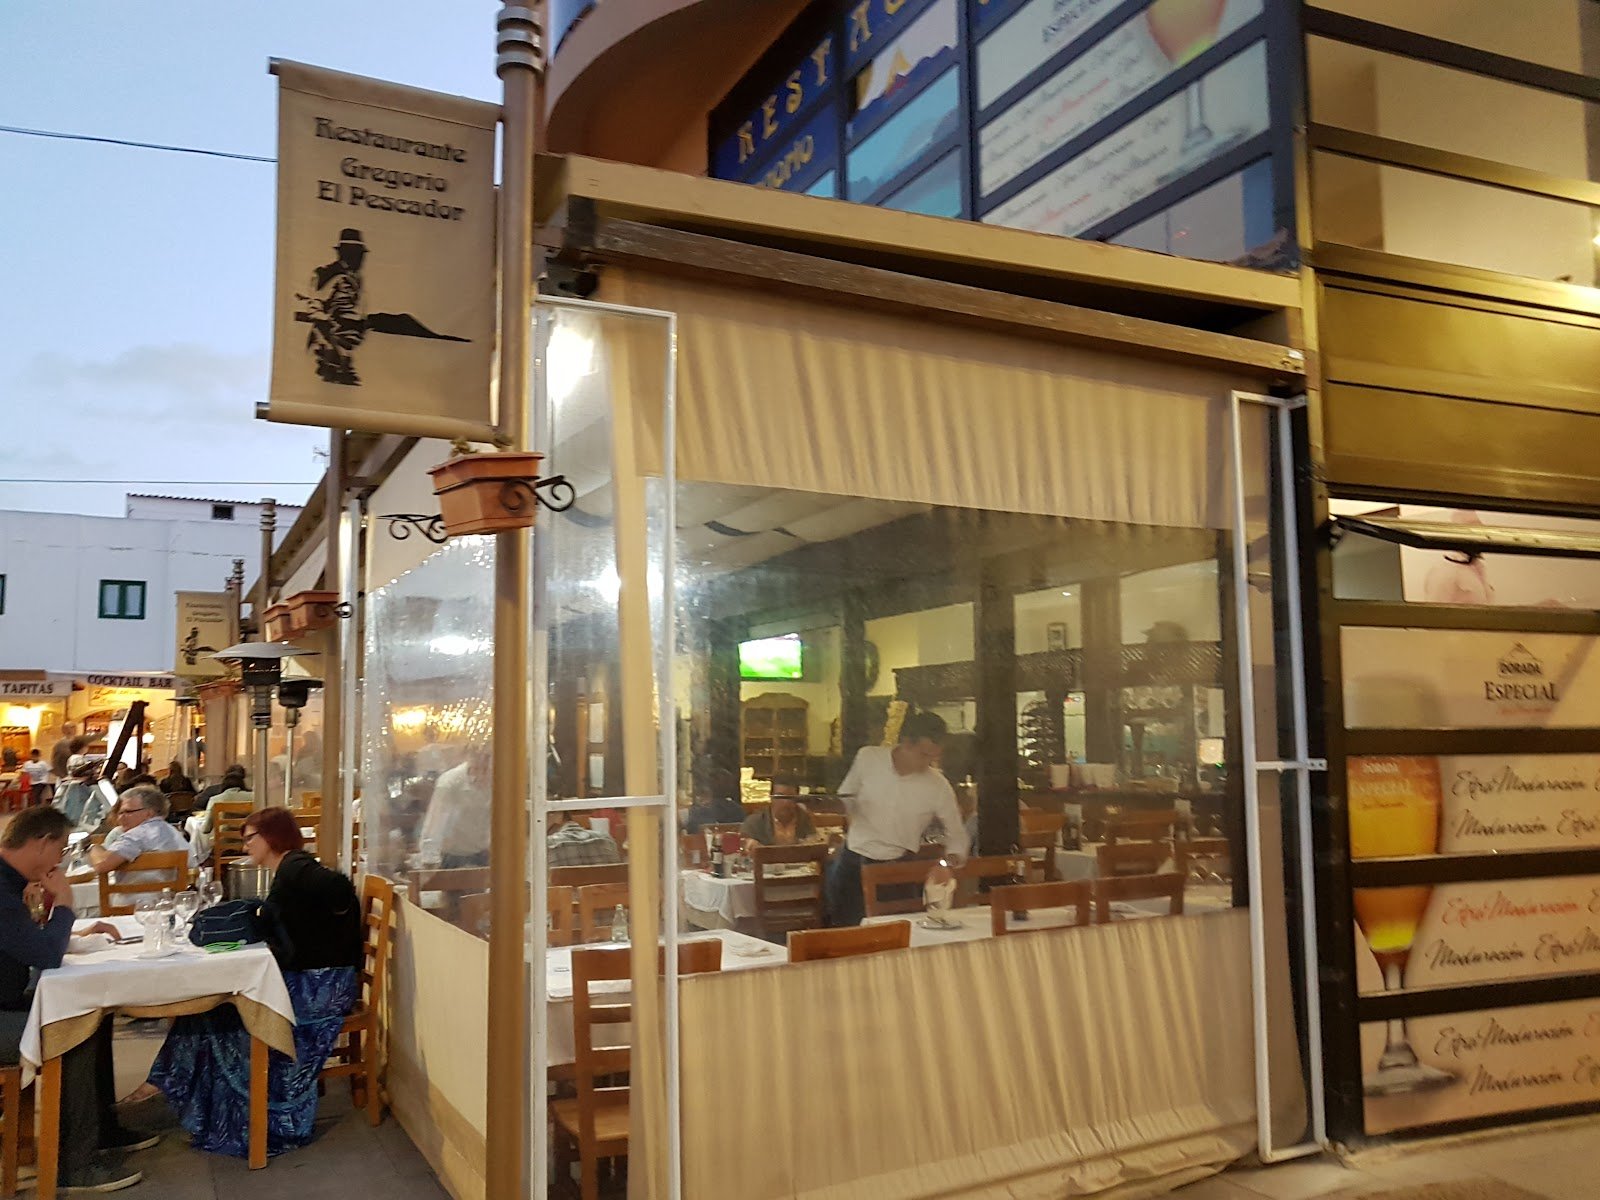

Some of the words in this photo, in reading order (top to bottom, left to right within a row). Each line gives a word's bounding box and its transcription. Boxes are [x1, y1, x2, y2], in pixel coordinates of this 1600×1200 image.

[315, 117, 467, 163] Restaurante
[340, 157, 447, 192] Gregorio
[316, 180, 342, 203] El
[349, 186, 465, 221] Pescador
[2, 682, 53, 695] TAPITAS
[87, 674, 144, 687] COCKTAIL
[149, 677, 172, 688] BAR
